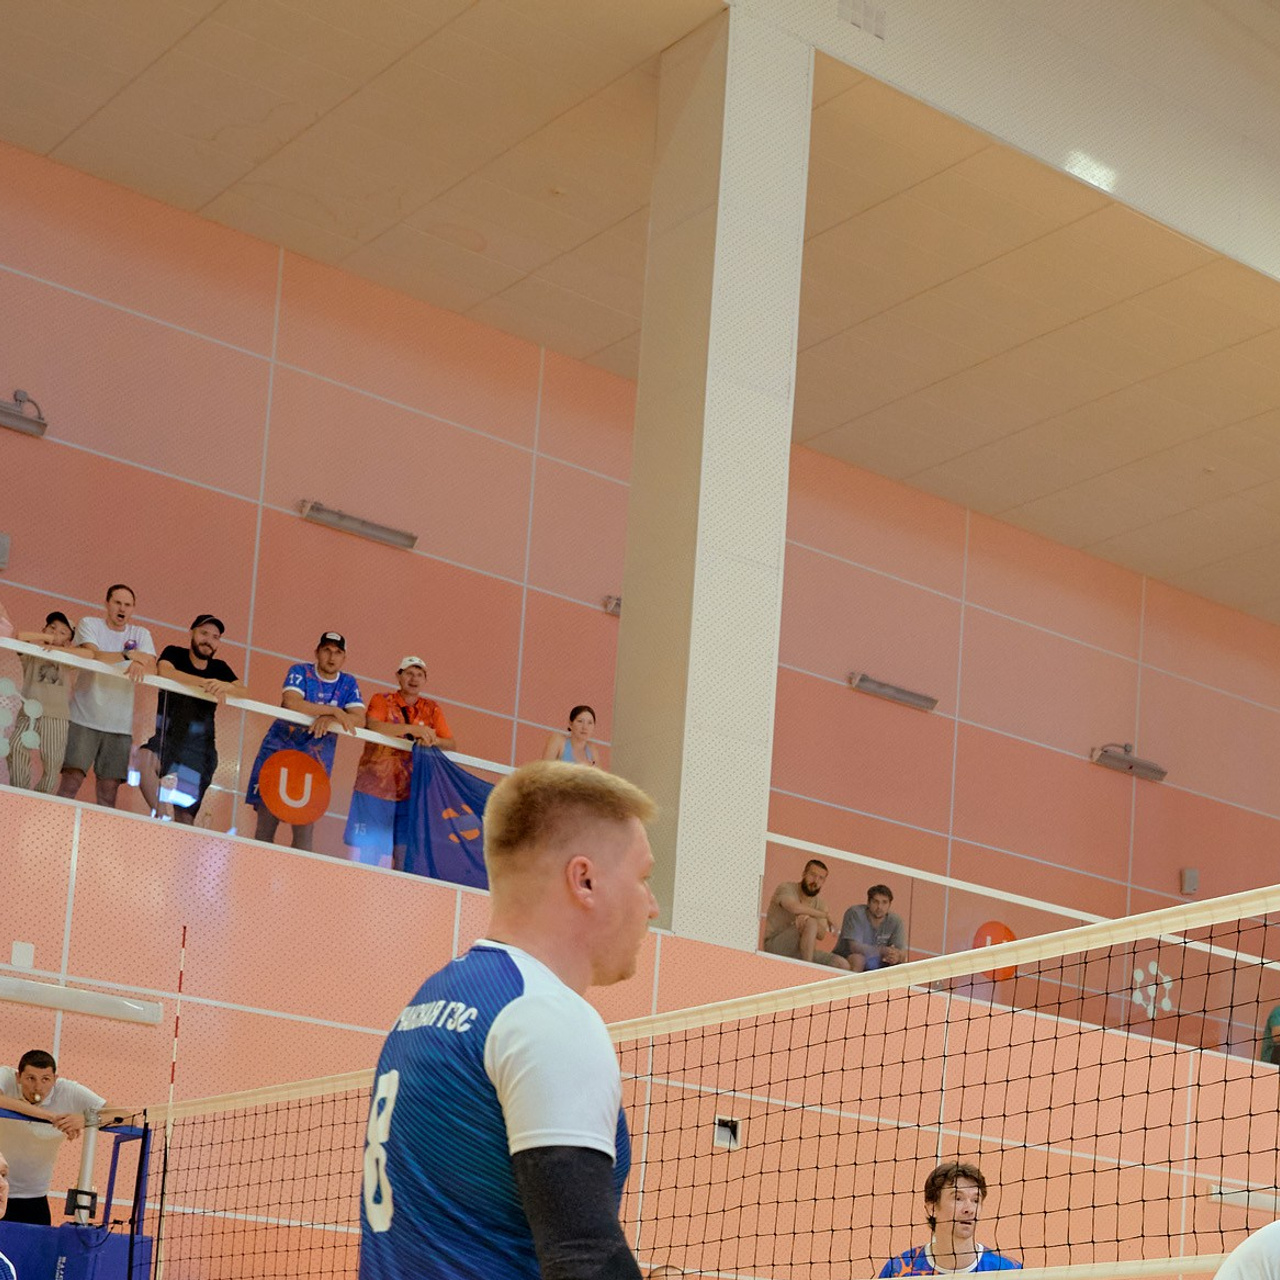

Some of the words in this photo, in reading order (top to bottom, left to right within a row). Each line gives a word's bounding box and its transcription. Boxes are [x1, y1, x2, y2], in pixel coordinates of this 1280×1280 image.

[288, 673, 303, 684] 17
[279, 767, 312, 808] U
[436, 1001, 479, 1033] ГЭС
[363, 1069, 400, 1232] 8
